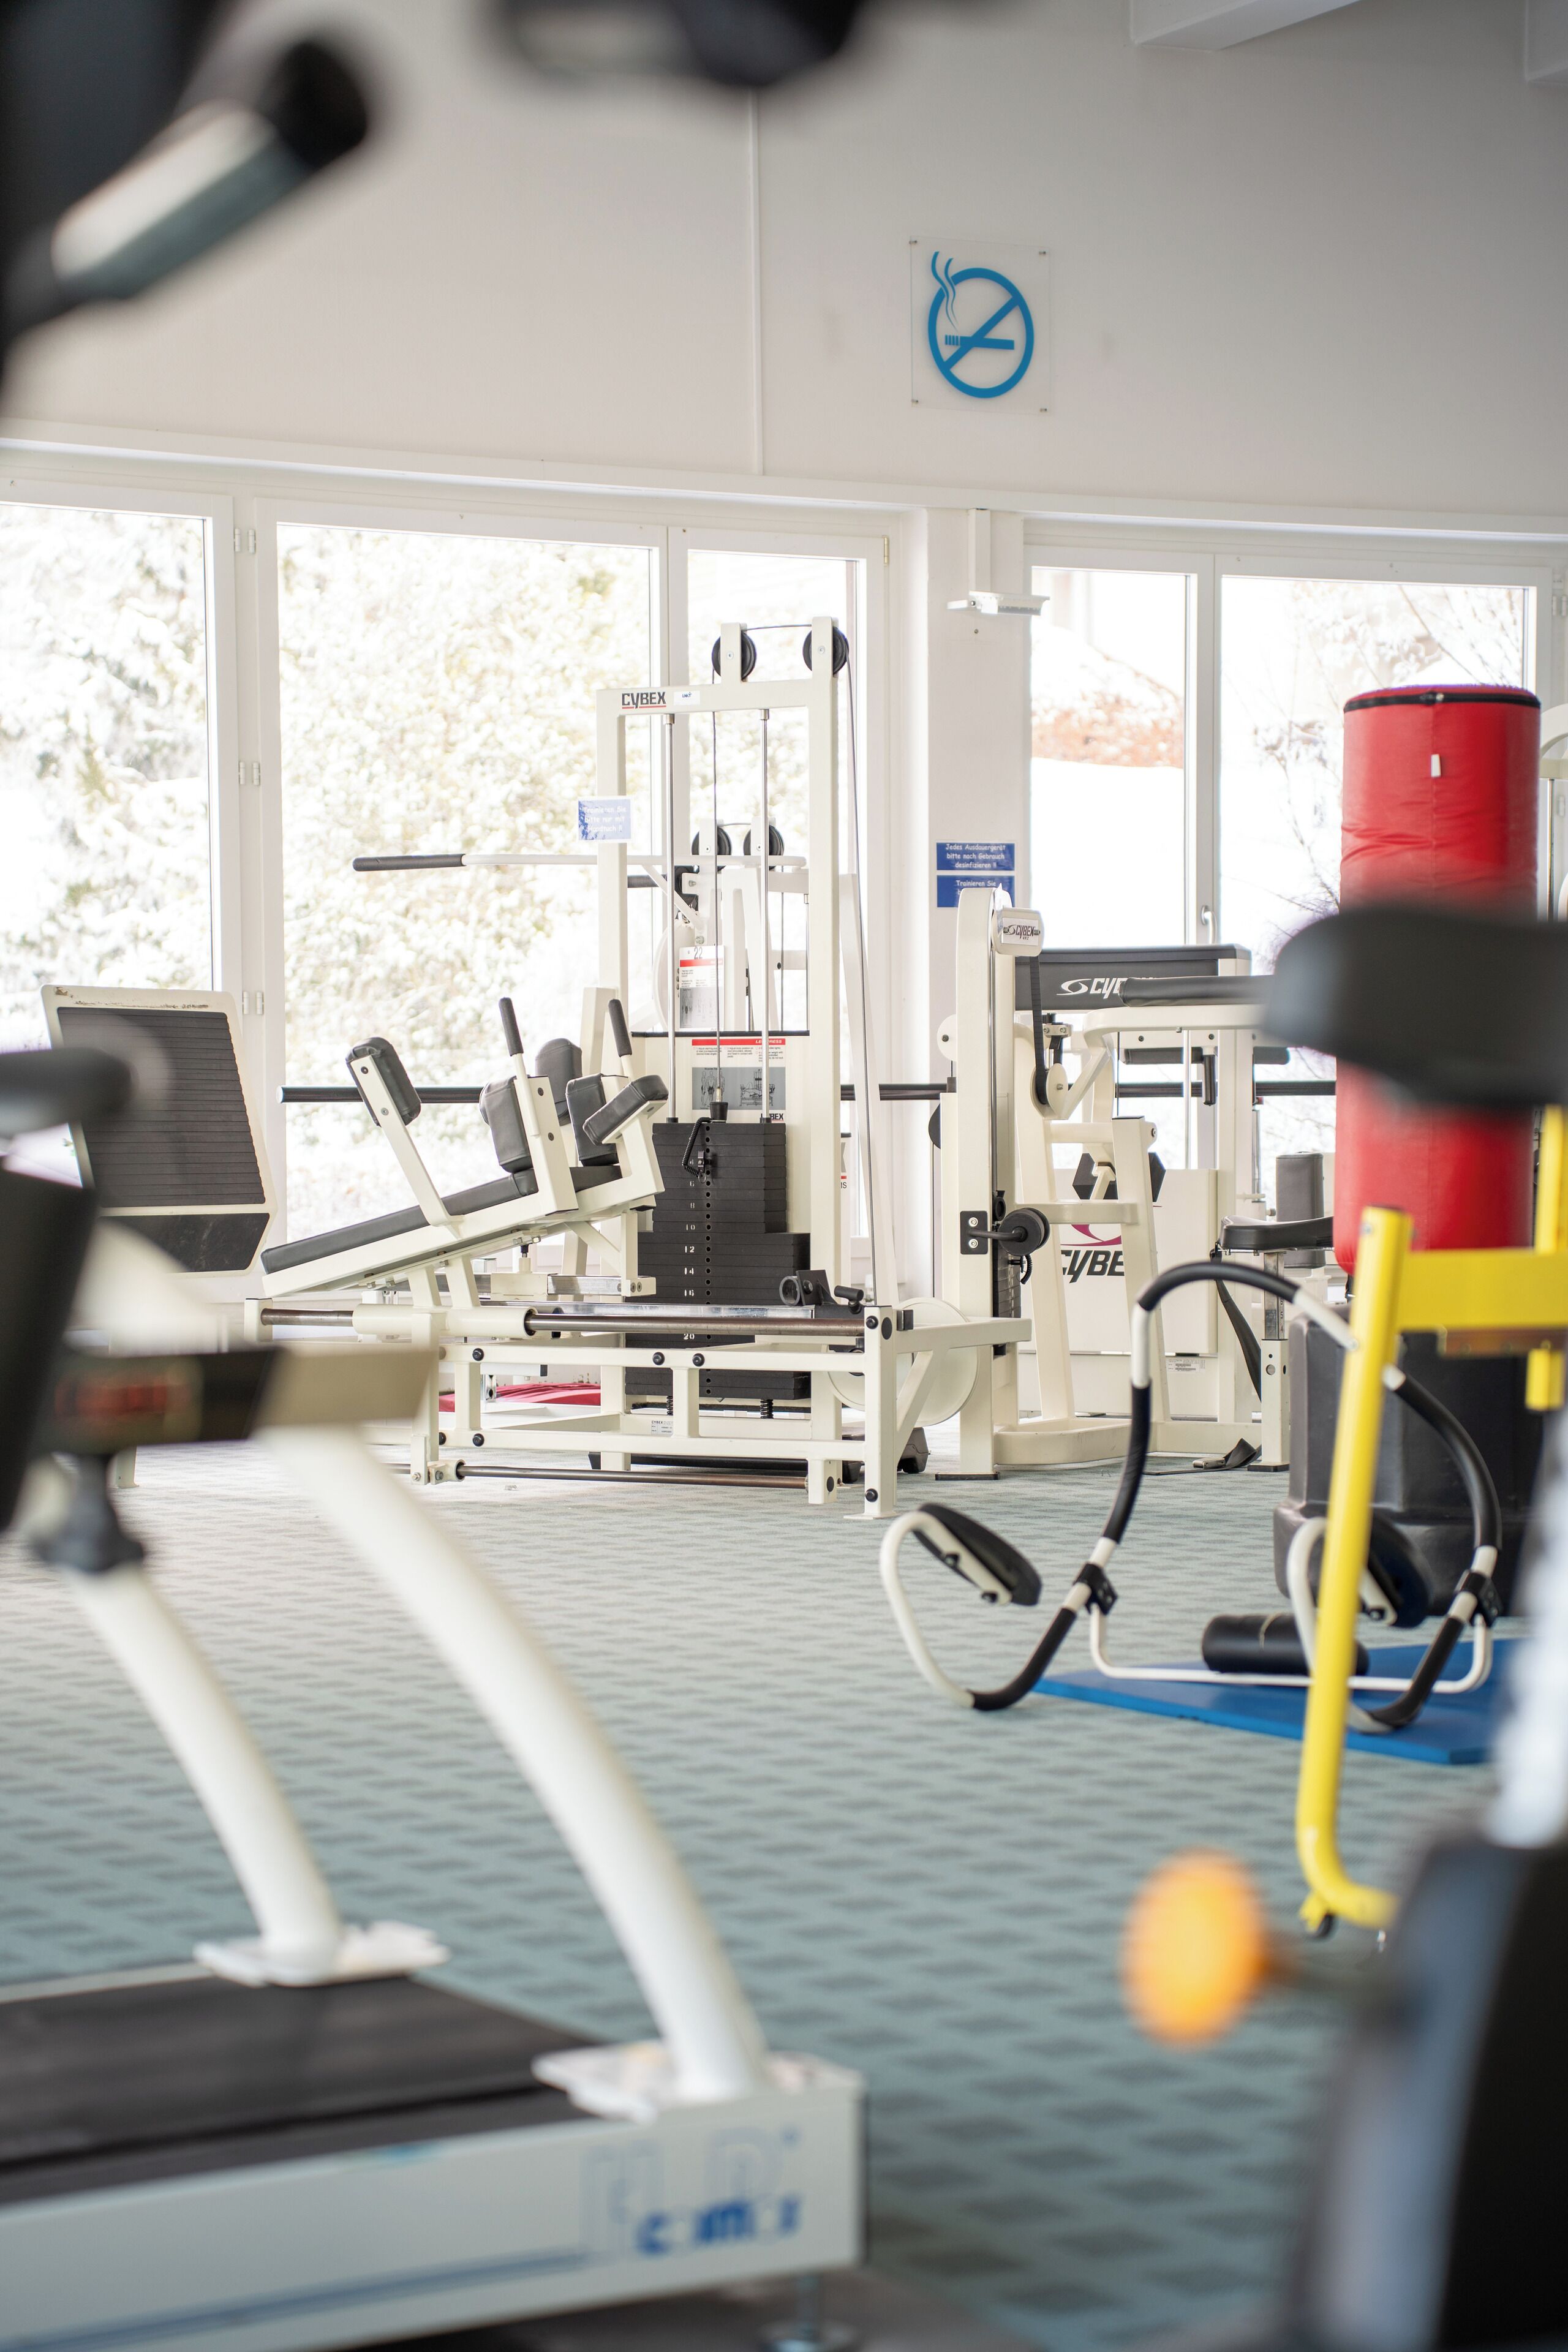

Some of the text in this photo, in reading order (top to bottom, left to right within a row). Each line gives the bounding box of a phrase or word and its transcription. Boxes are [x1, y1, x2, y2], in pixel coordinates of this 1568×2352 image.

[622, 692, 666, 709] CYBEX
[1016, 924, 1035, 939] CYBEX
[1061, 1250, 1125, 1284] YBE
